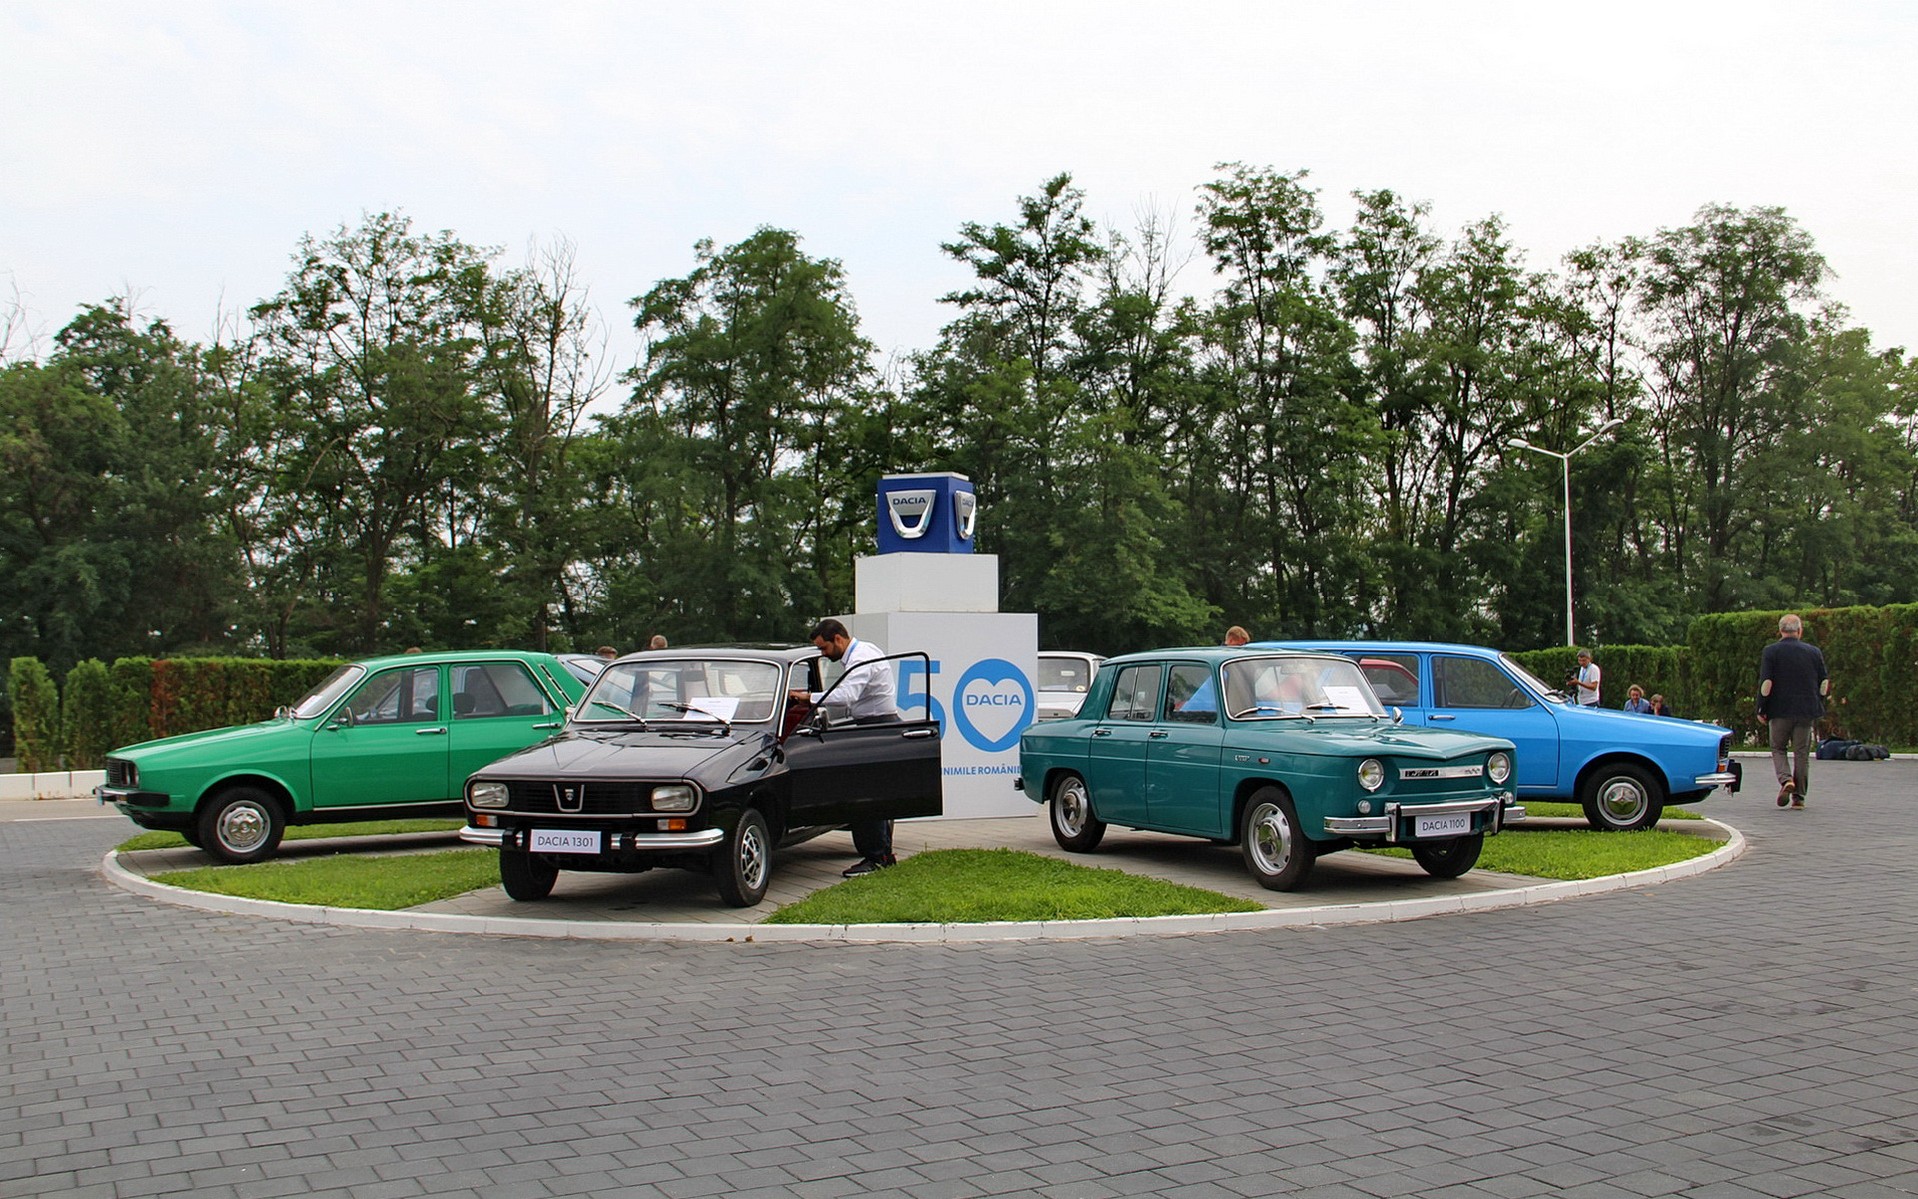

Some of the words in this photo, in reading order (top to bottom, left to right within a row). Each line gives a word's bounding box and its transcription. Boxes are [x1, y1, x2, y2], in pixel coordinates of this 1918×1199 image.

[893, 497, 926, 505] DACIA
[966, 694, 1022, 706] DACIA
[941, 766, 977, 776] NIMILE
[1422, 821, 1448, 831] DACIA
[1449, 819, 1466, 829] 1100
[537, 836, 570, 847] DACIA
[572, 837, 594, 848] 1301
